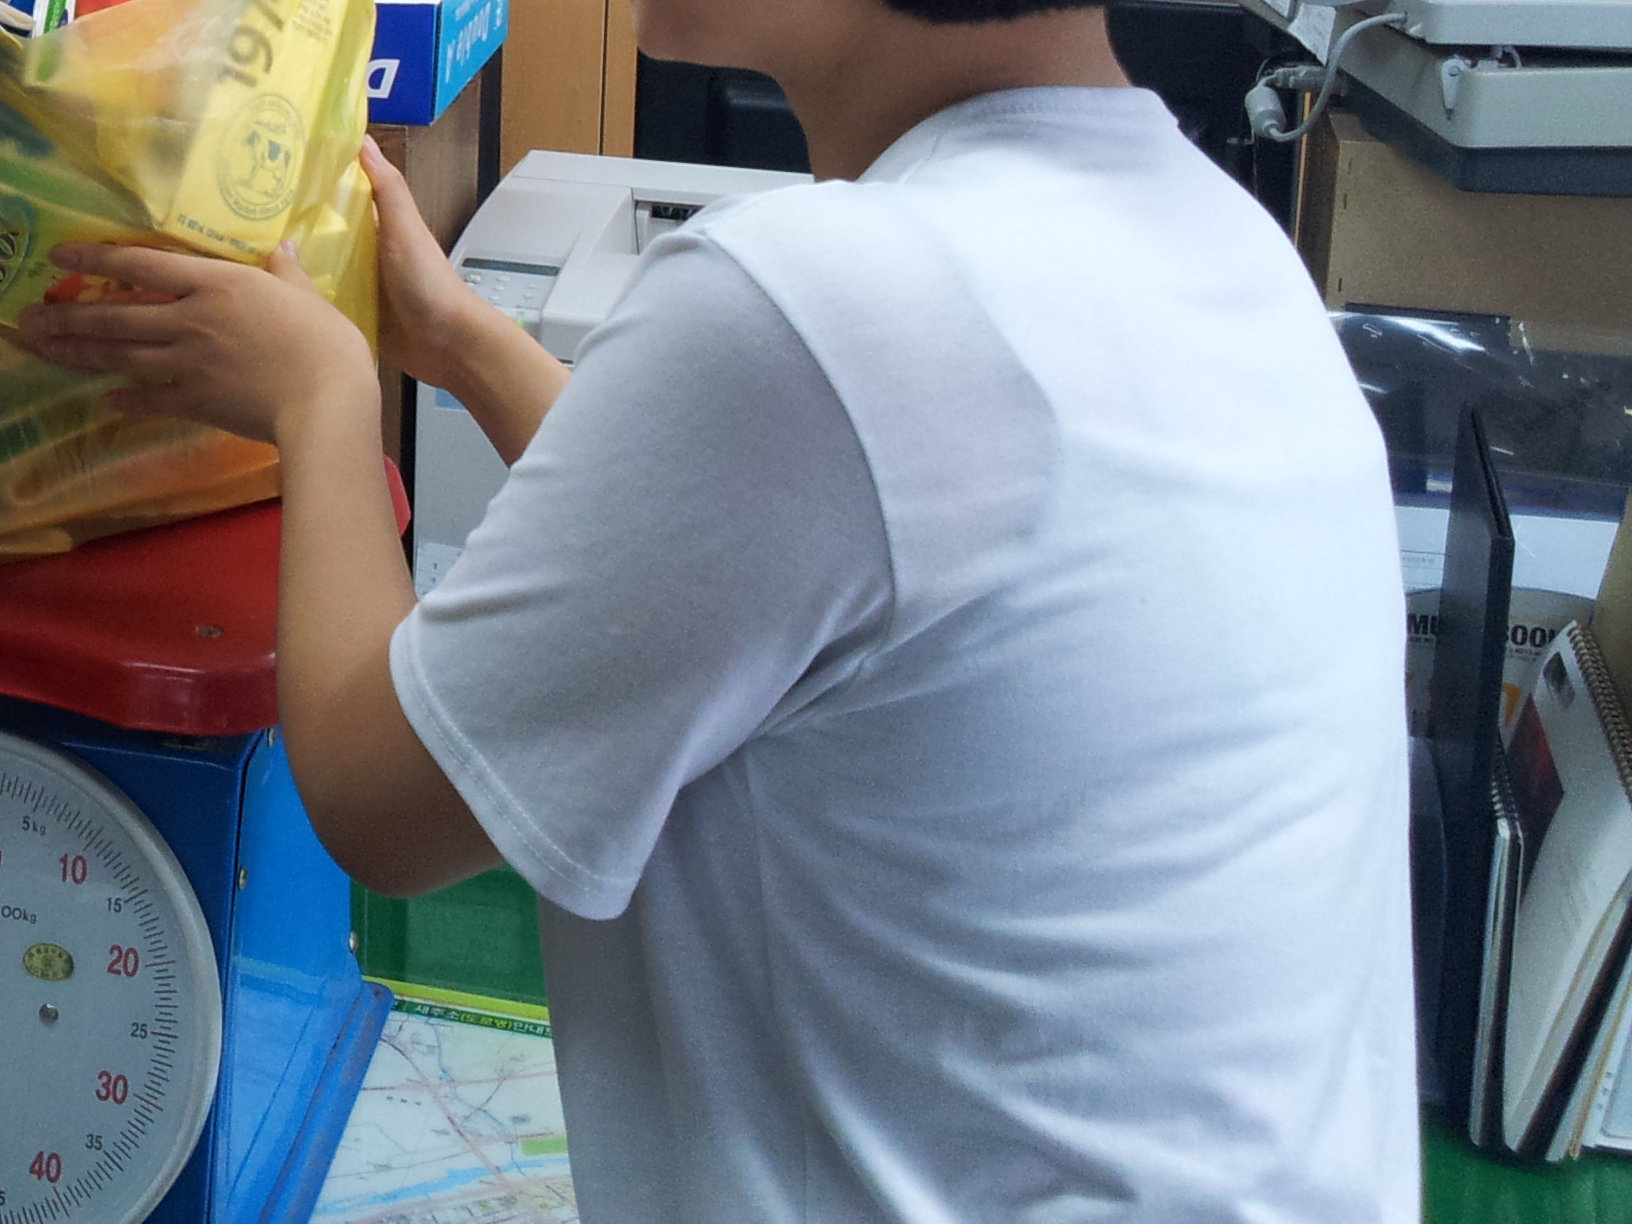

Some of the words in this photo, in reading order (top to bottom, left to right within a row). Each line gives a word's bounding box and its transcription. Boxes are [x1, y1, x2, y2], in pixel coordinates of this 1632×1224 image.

[367, 58, 401, 99] D
[22, 815, 47, 836] 5kg
[59, 853, 88, 885] 10
[105, 896, 123, 914] 15
[107, 944, 139, 978] 20
[130, 1022, 148, 1040] 25
[96, 1069, 129, 1105] 30
[84, 1132, 104, 1151] 35
[29, 1150, 61, 1183] 40
